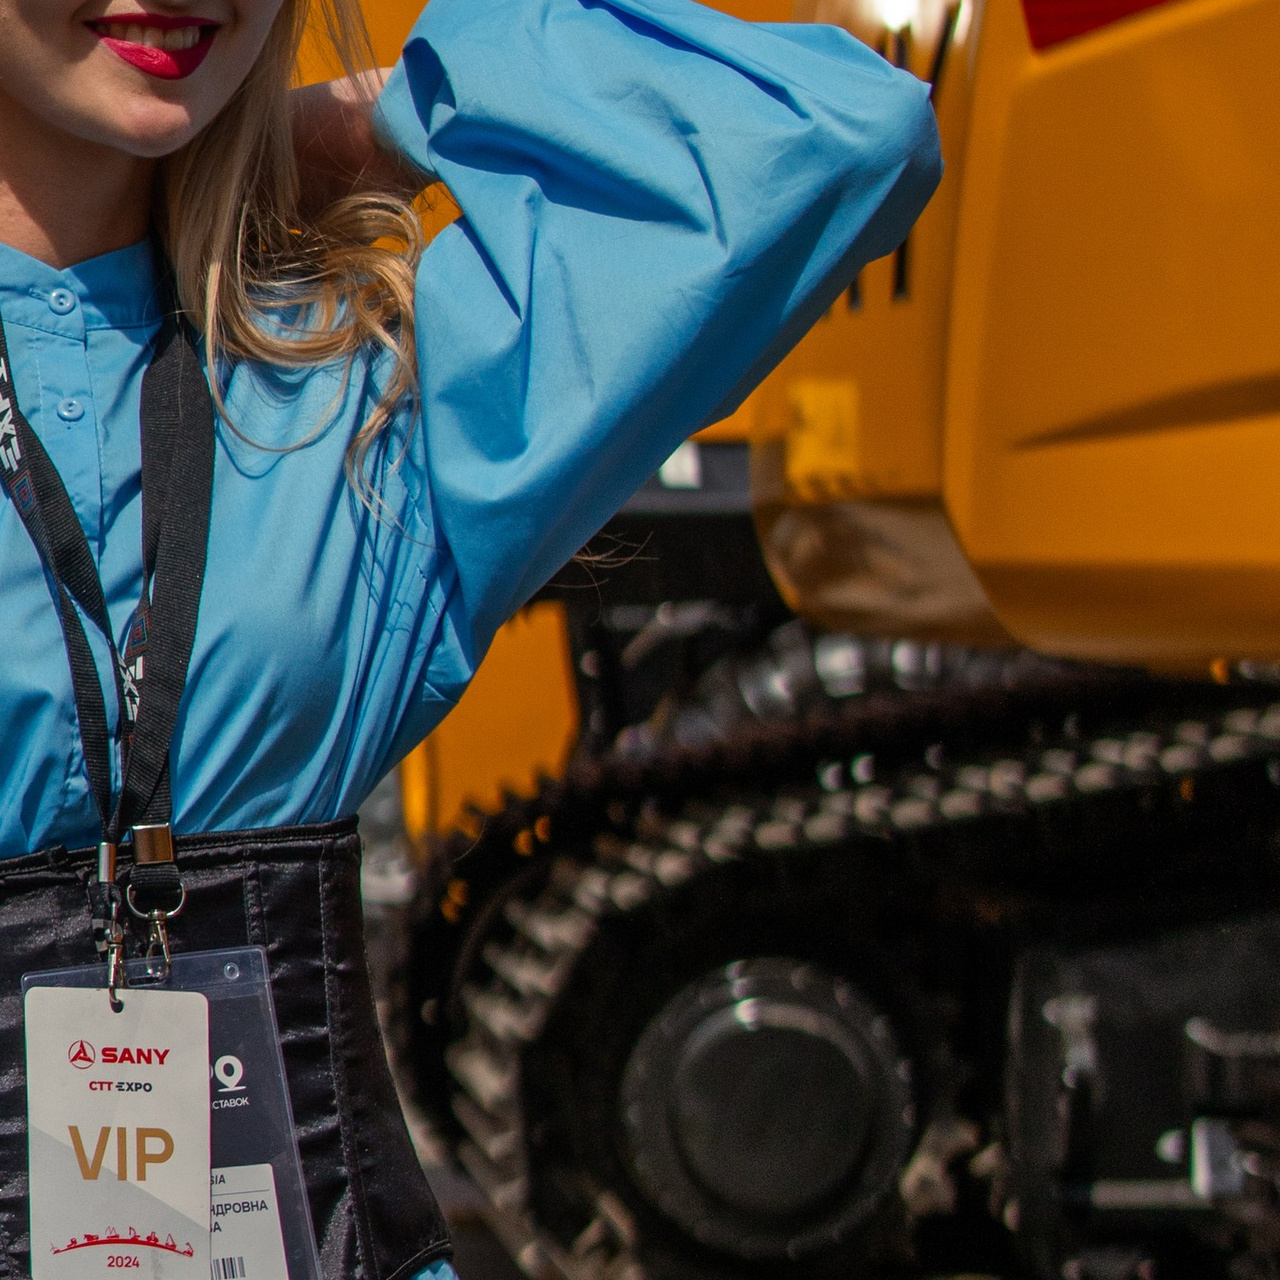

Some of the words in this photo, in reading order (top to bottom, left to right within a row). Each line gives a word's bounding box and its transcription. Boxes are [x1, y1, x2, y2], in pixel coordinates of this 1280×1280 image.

[101, 1047, 170, 1065] SANY
[116, 1082, 152, 1092] EXPO
[68, 1125, 174, 1181] VIP
[107, 1256, 140, 1268] 2024
